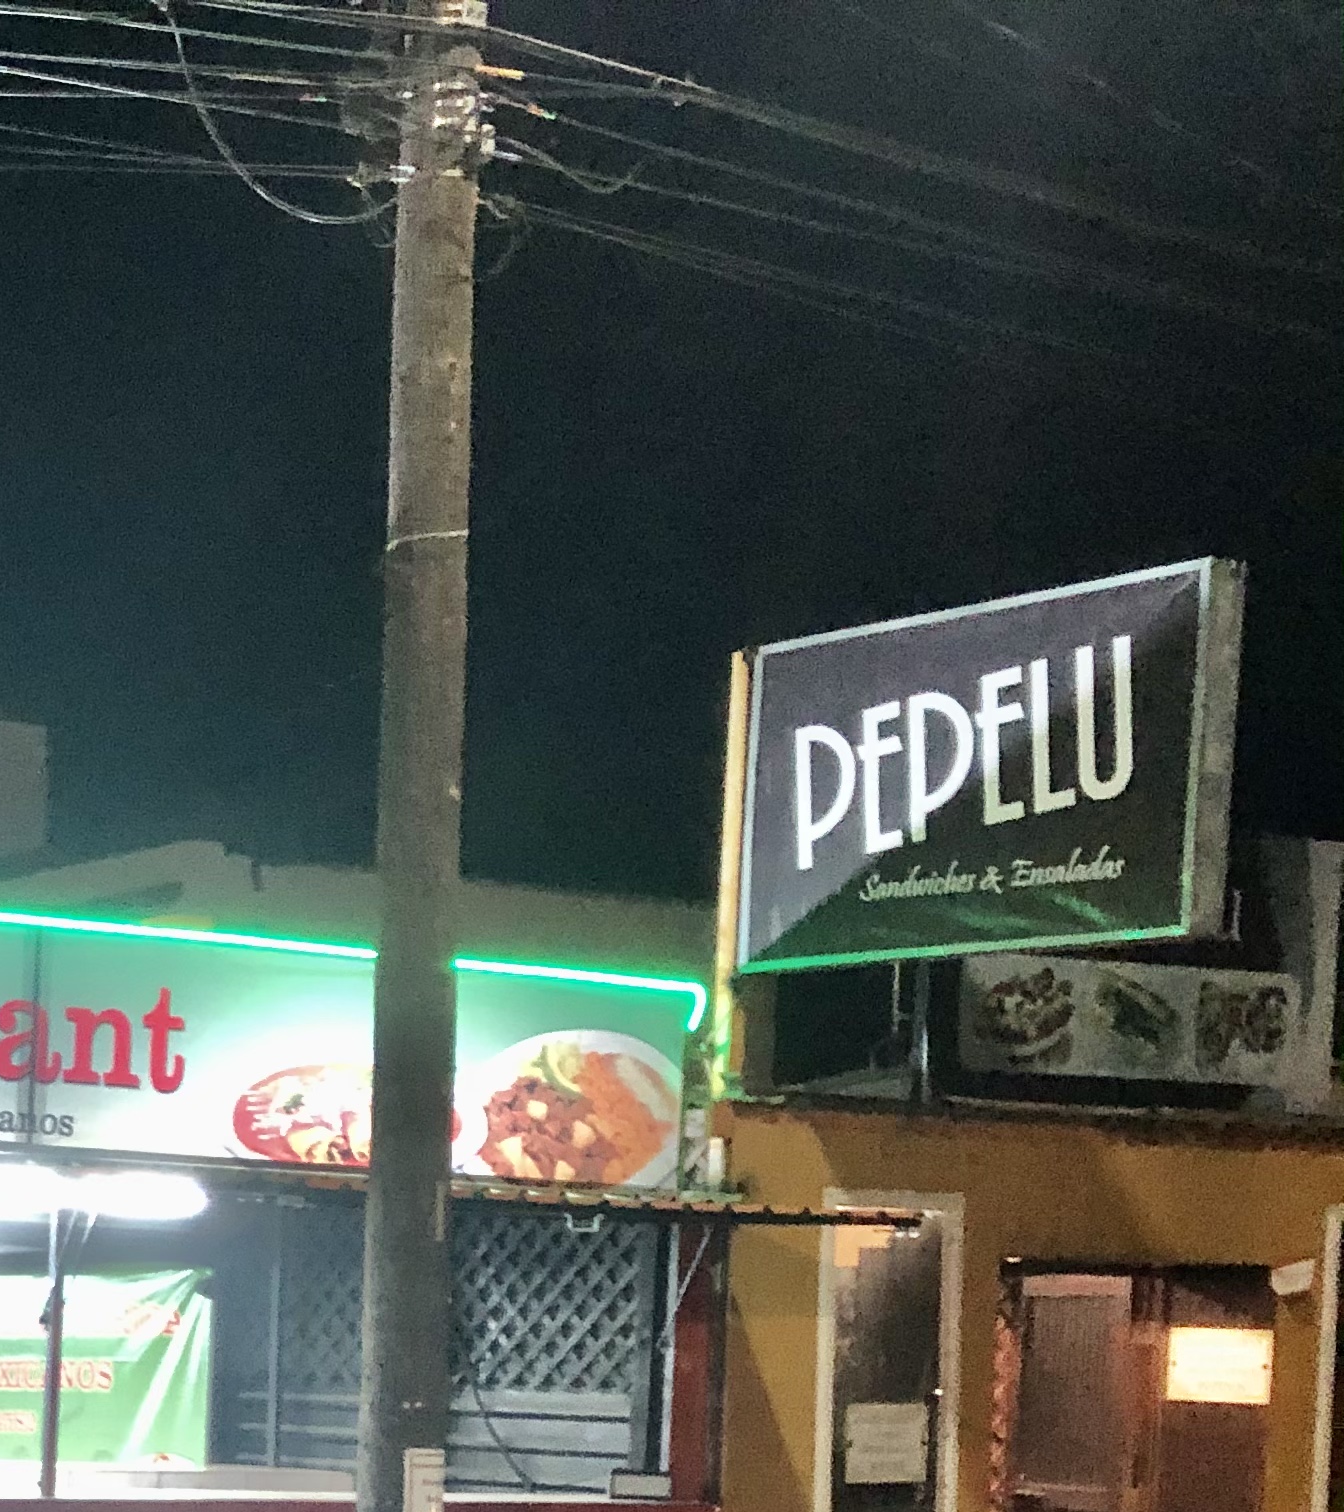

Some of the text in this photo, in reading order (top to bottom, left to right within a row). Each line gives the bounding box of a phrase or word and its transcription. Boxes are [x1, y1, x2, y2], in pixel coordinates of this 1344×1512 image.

[794, 634, 1134, 871] PEPELU
[859, 845, 1125, 901] Sandwiches & Ensaladas
